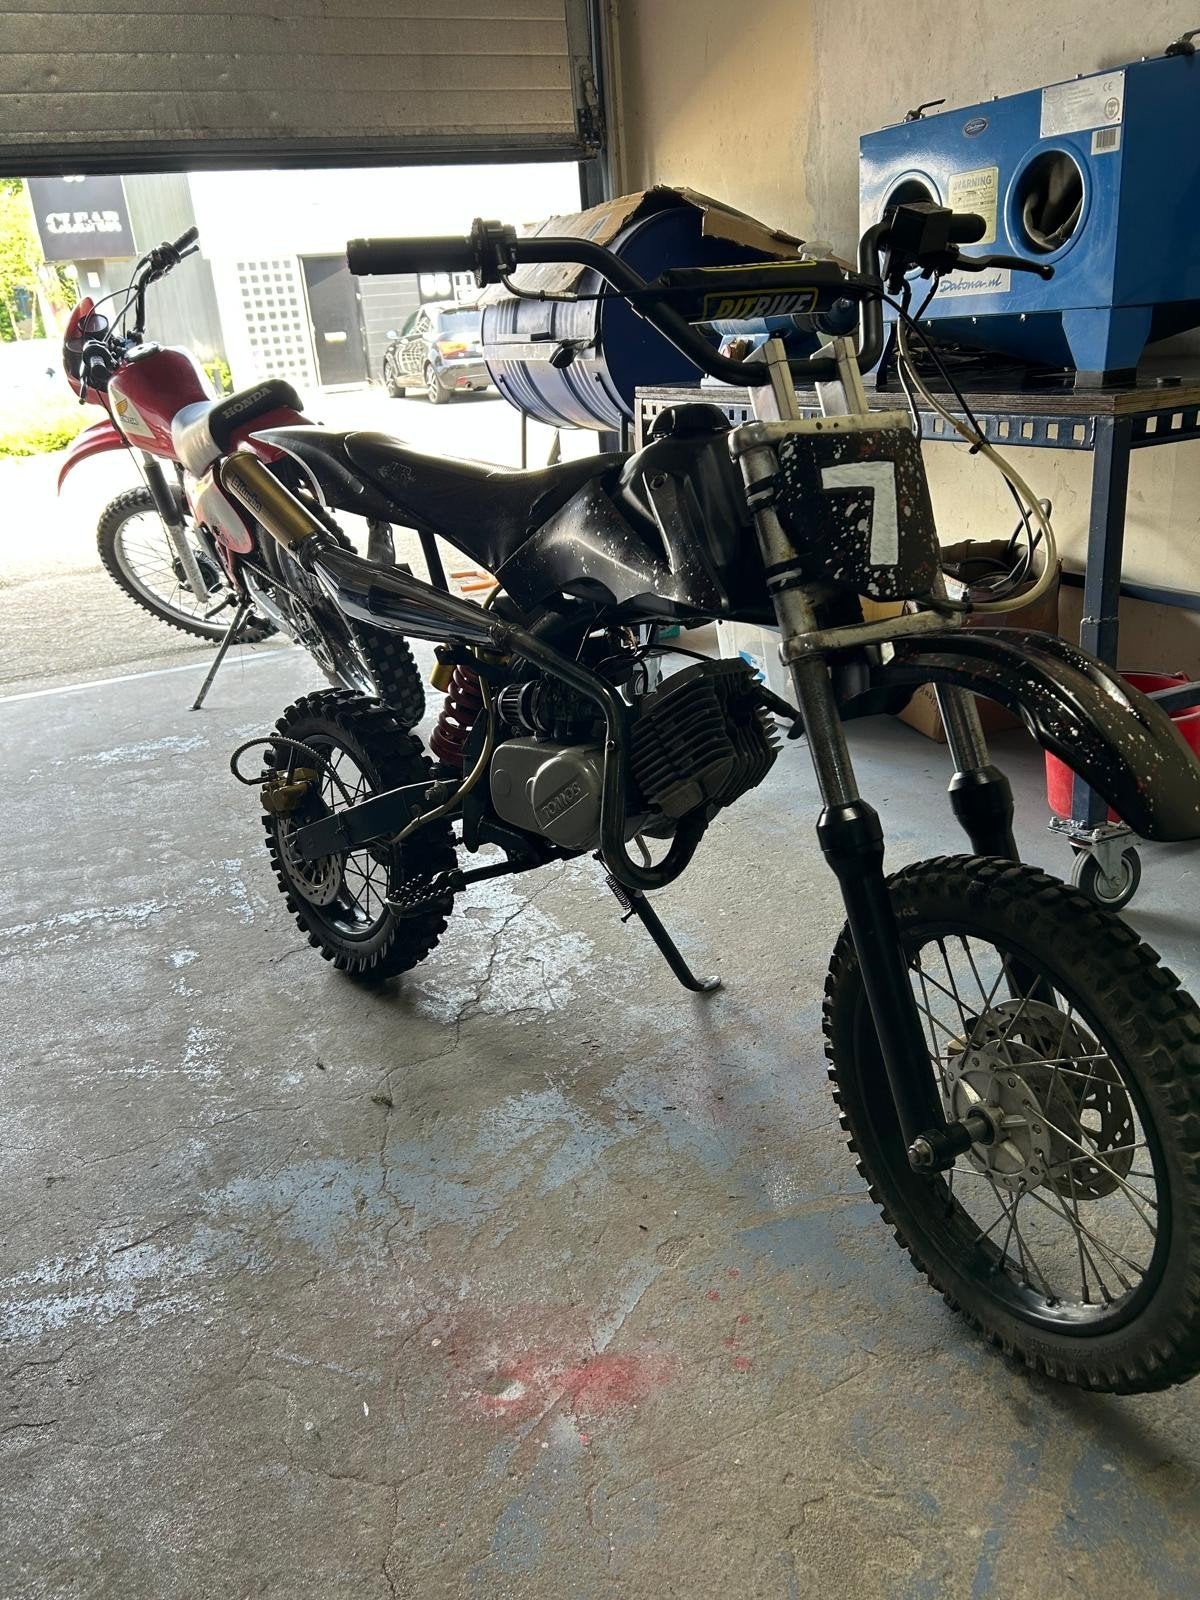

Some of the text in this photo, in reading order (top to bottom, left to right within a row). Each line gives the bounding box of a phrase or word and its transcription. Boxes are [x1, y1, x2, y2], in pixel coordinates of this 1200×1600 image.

[953, 175, 992, 191] WARNING
[222, 387, 272, 419] HONDA
[820, 461, 899, 565] 7
[541, 782, 581, 820] TOMOS
